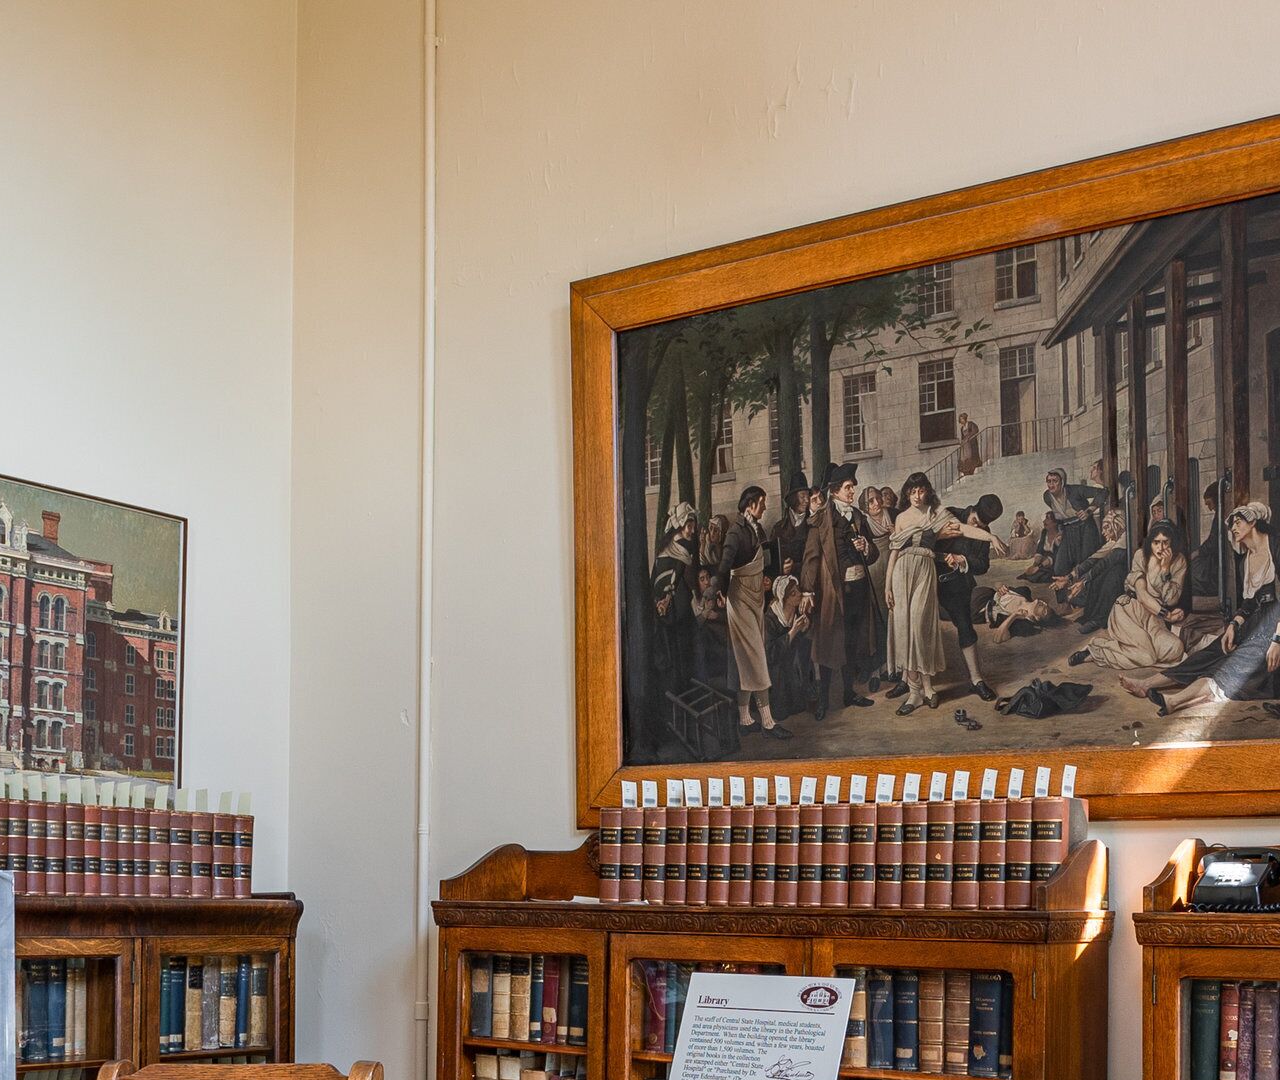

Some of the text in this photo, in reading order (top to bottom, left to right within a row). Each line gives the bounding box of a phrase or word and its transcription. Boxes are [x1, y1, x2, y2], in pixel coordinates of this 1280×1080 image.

[698, 996, 729, 1006] Library
[713, 1024, 739, 1032] physicians
[794, 1028, 826, 1037] Pathological
